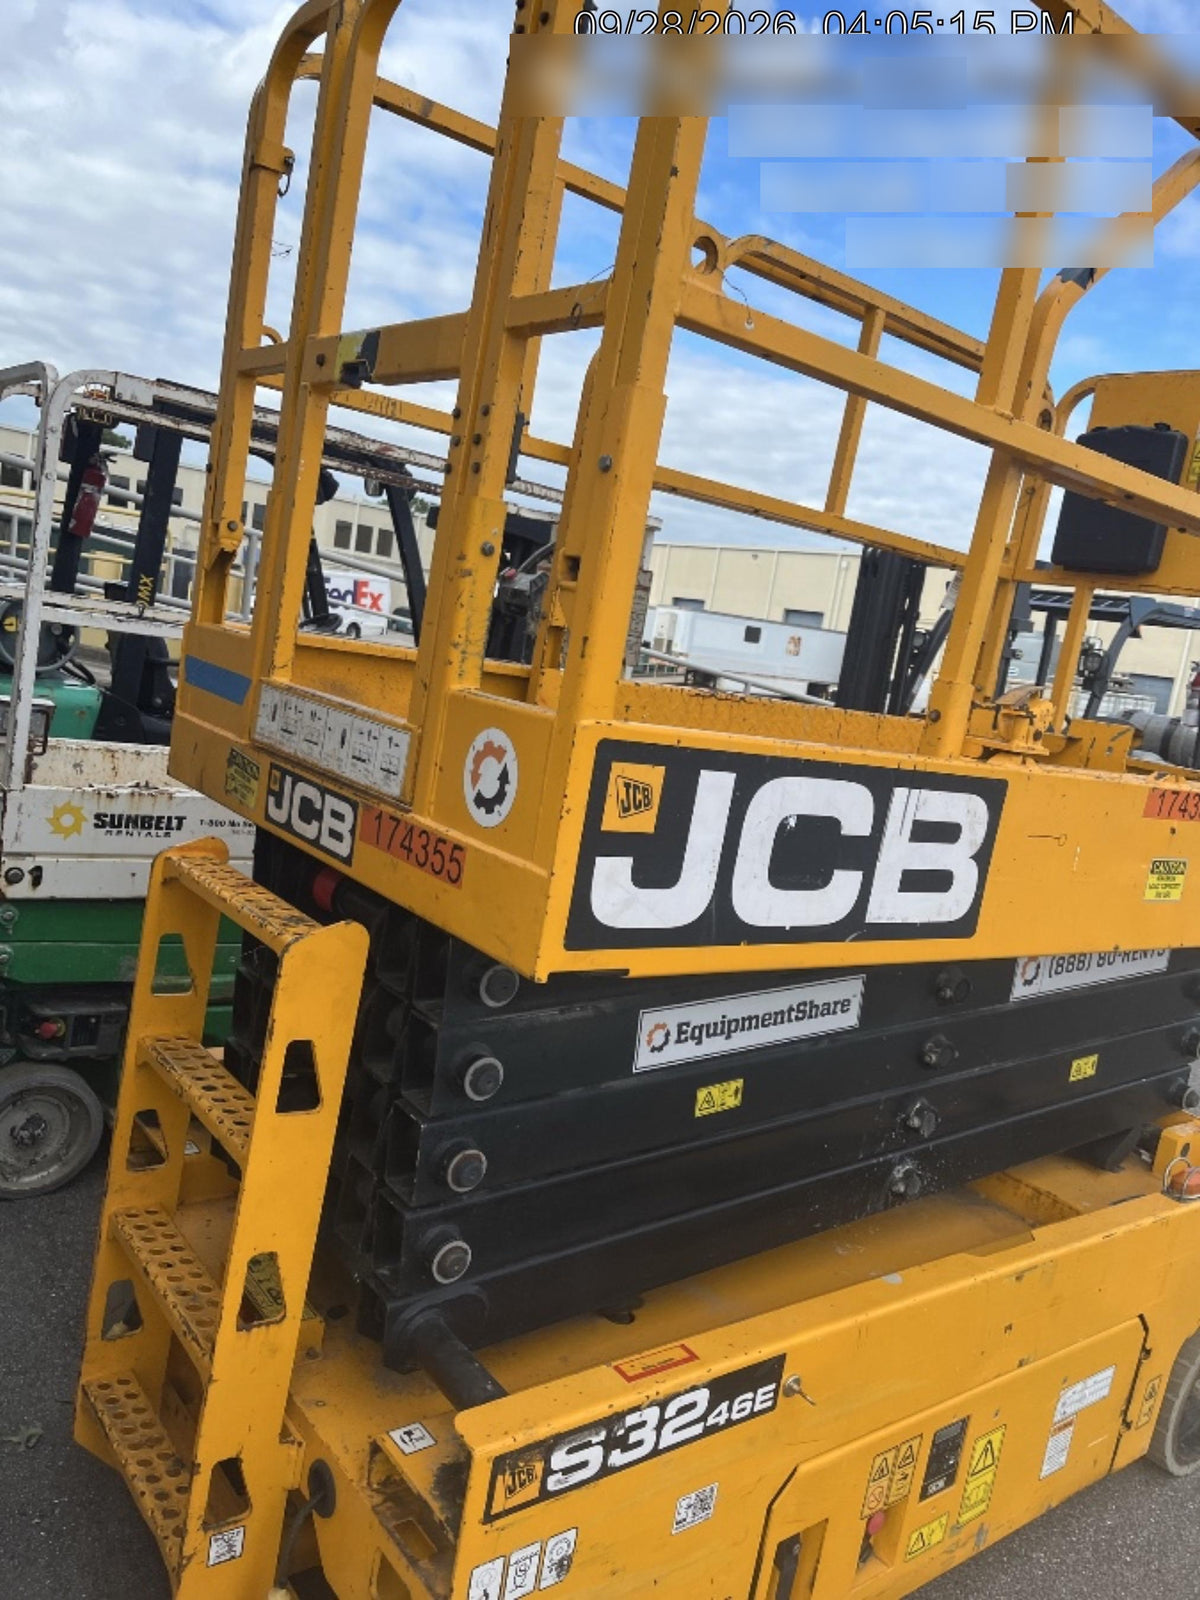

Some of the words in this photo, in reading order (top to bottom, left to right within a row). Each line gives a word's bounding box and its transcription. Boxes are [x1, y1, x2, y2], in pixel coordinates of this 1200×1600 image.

[324, 577, 384, 612] edEx
[620, 781, 651, 814] JCB
[1157, 789, 1200, 819] 1743
[93, 812, 187, 831] SUNBELT
[268, 774, 354, 857] JCB
[104, 829, 172, 838] RENTALS
[374, 810, 464, 884] 174355
[590, 769, 989, 929] JCB
[1048, 953, 1092, 978] (888)
[674, 998, 852, 1046] EquipmentShare
